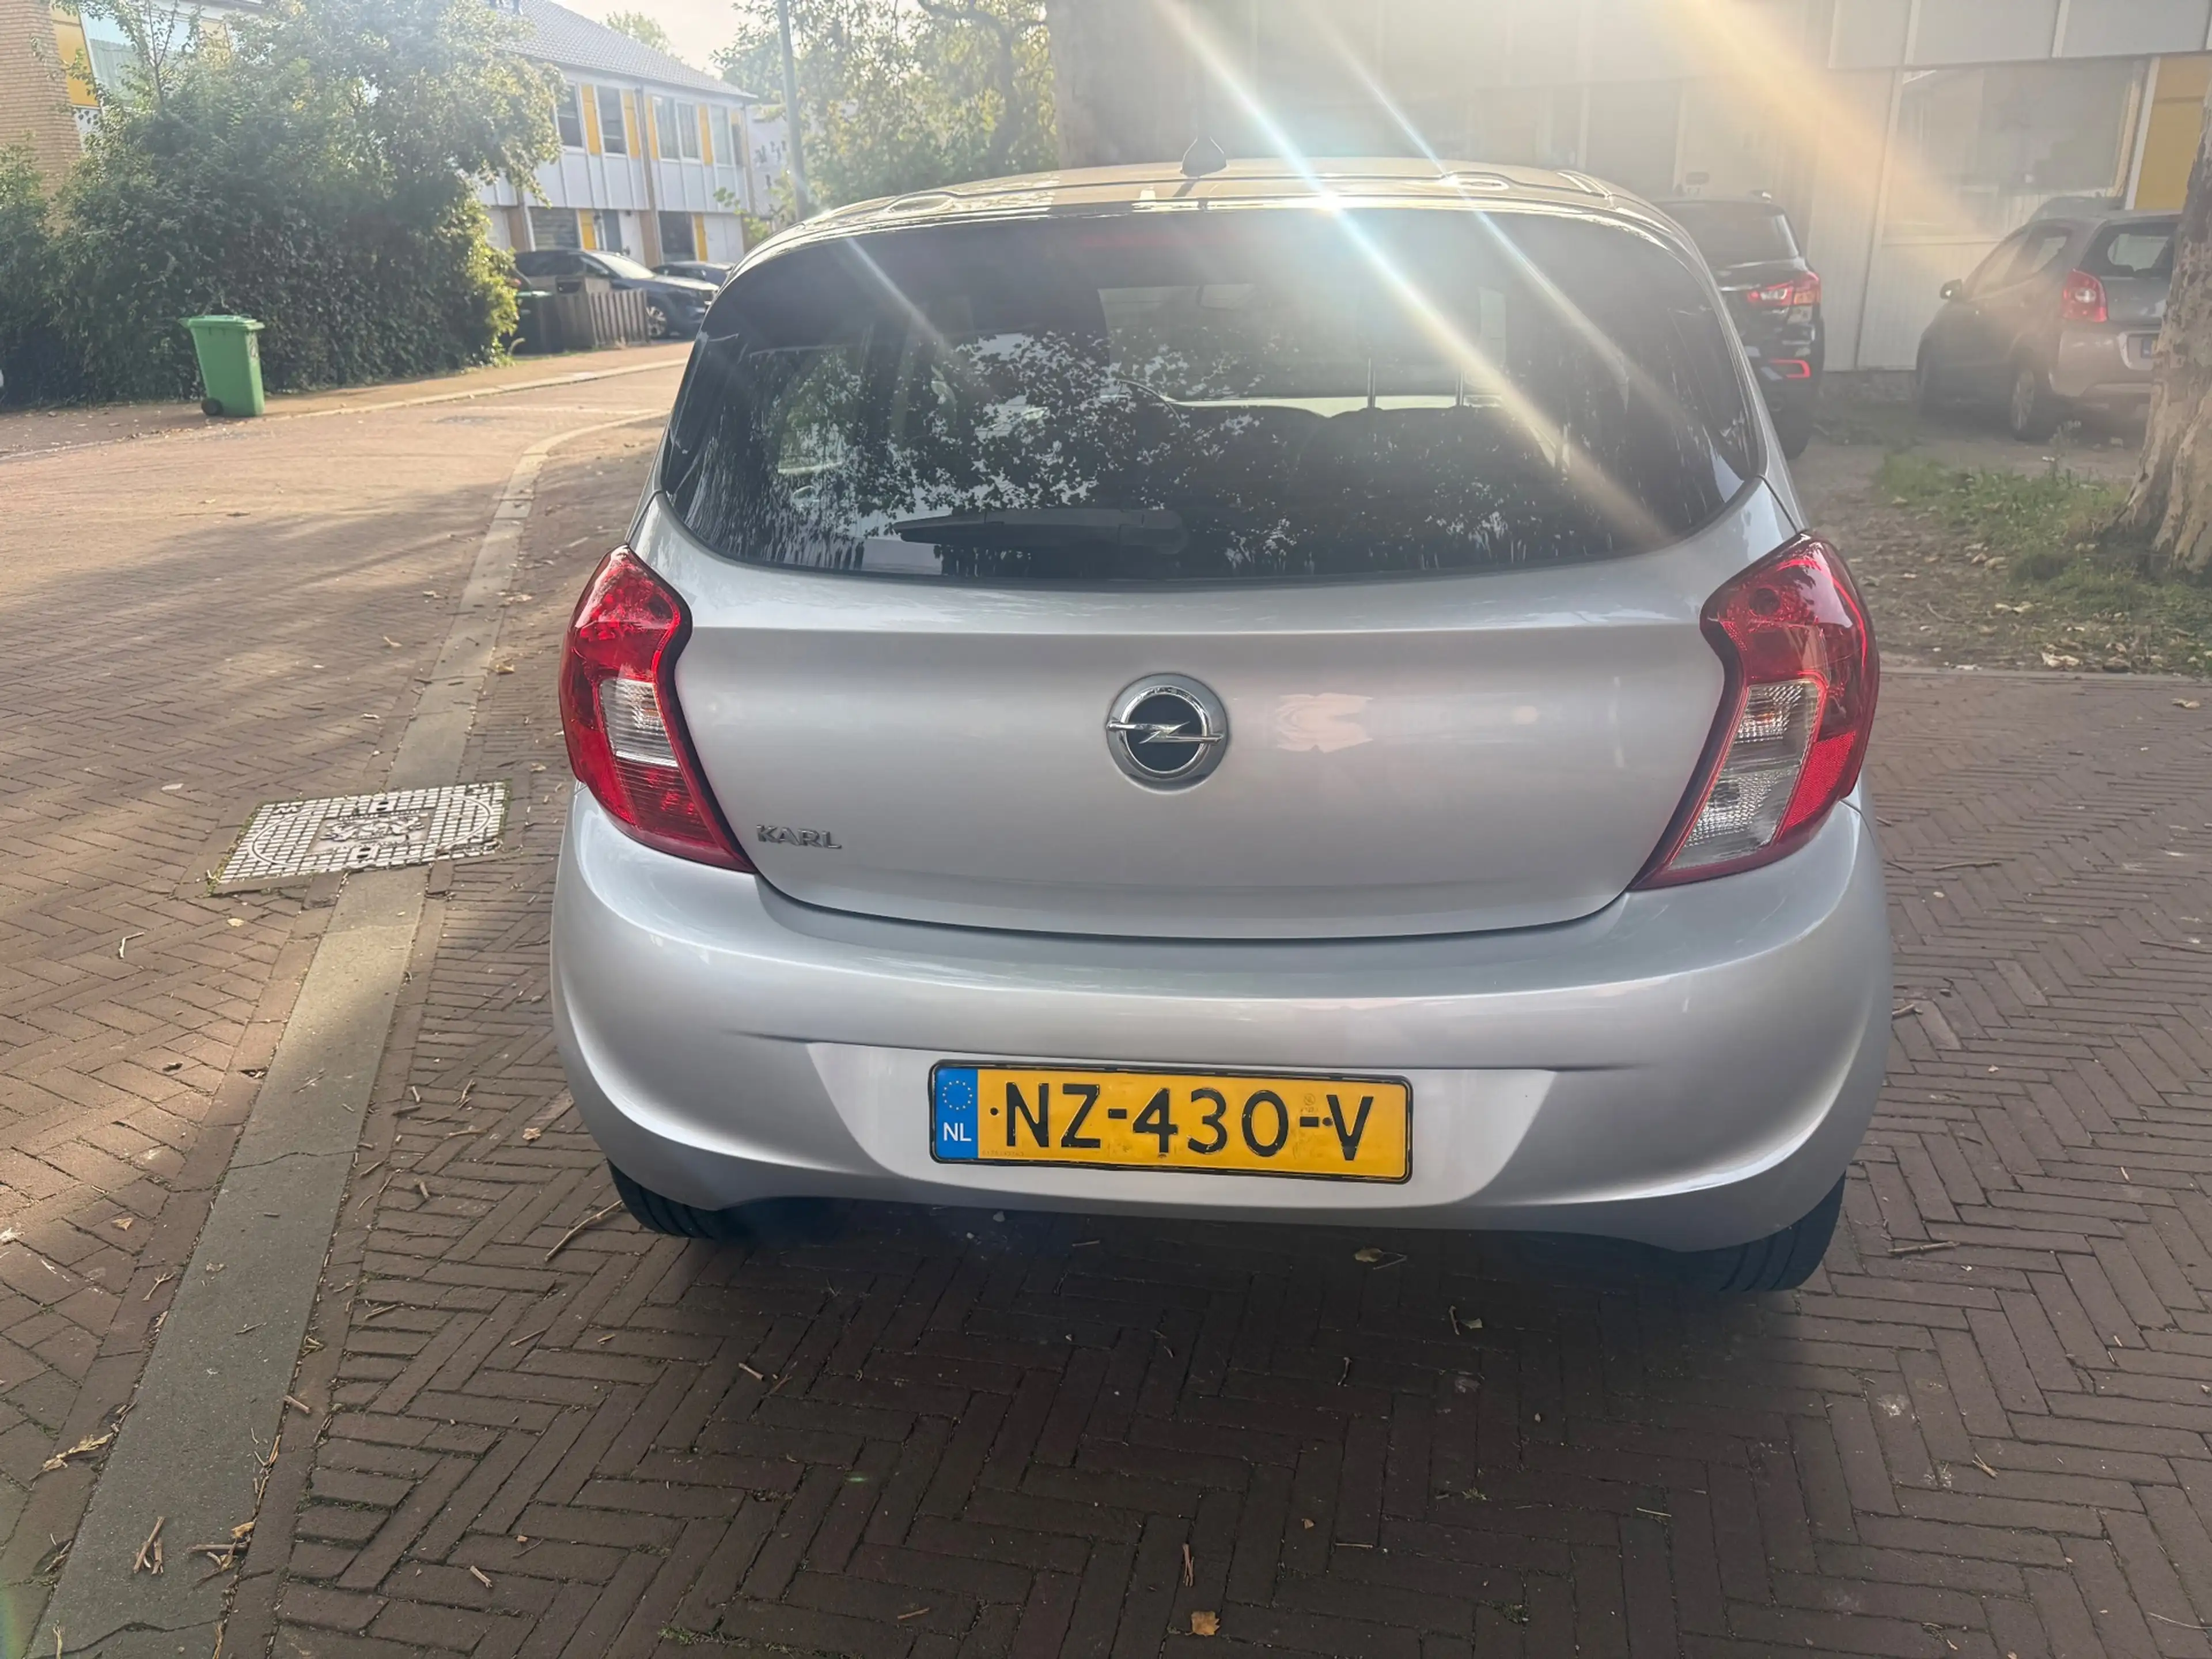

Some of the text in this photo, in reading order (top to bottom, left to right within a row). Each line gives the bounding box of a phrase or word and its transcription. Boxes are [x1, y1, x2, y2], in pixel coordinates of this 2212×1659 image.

[756, 825, 842, 849] KARL
[943, 1122, 972, 1141] NL
[1006, 1082, 1374, 1161] NZ-430-V
